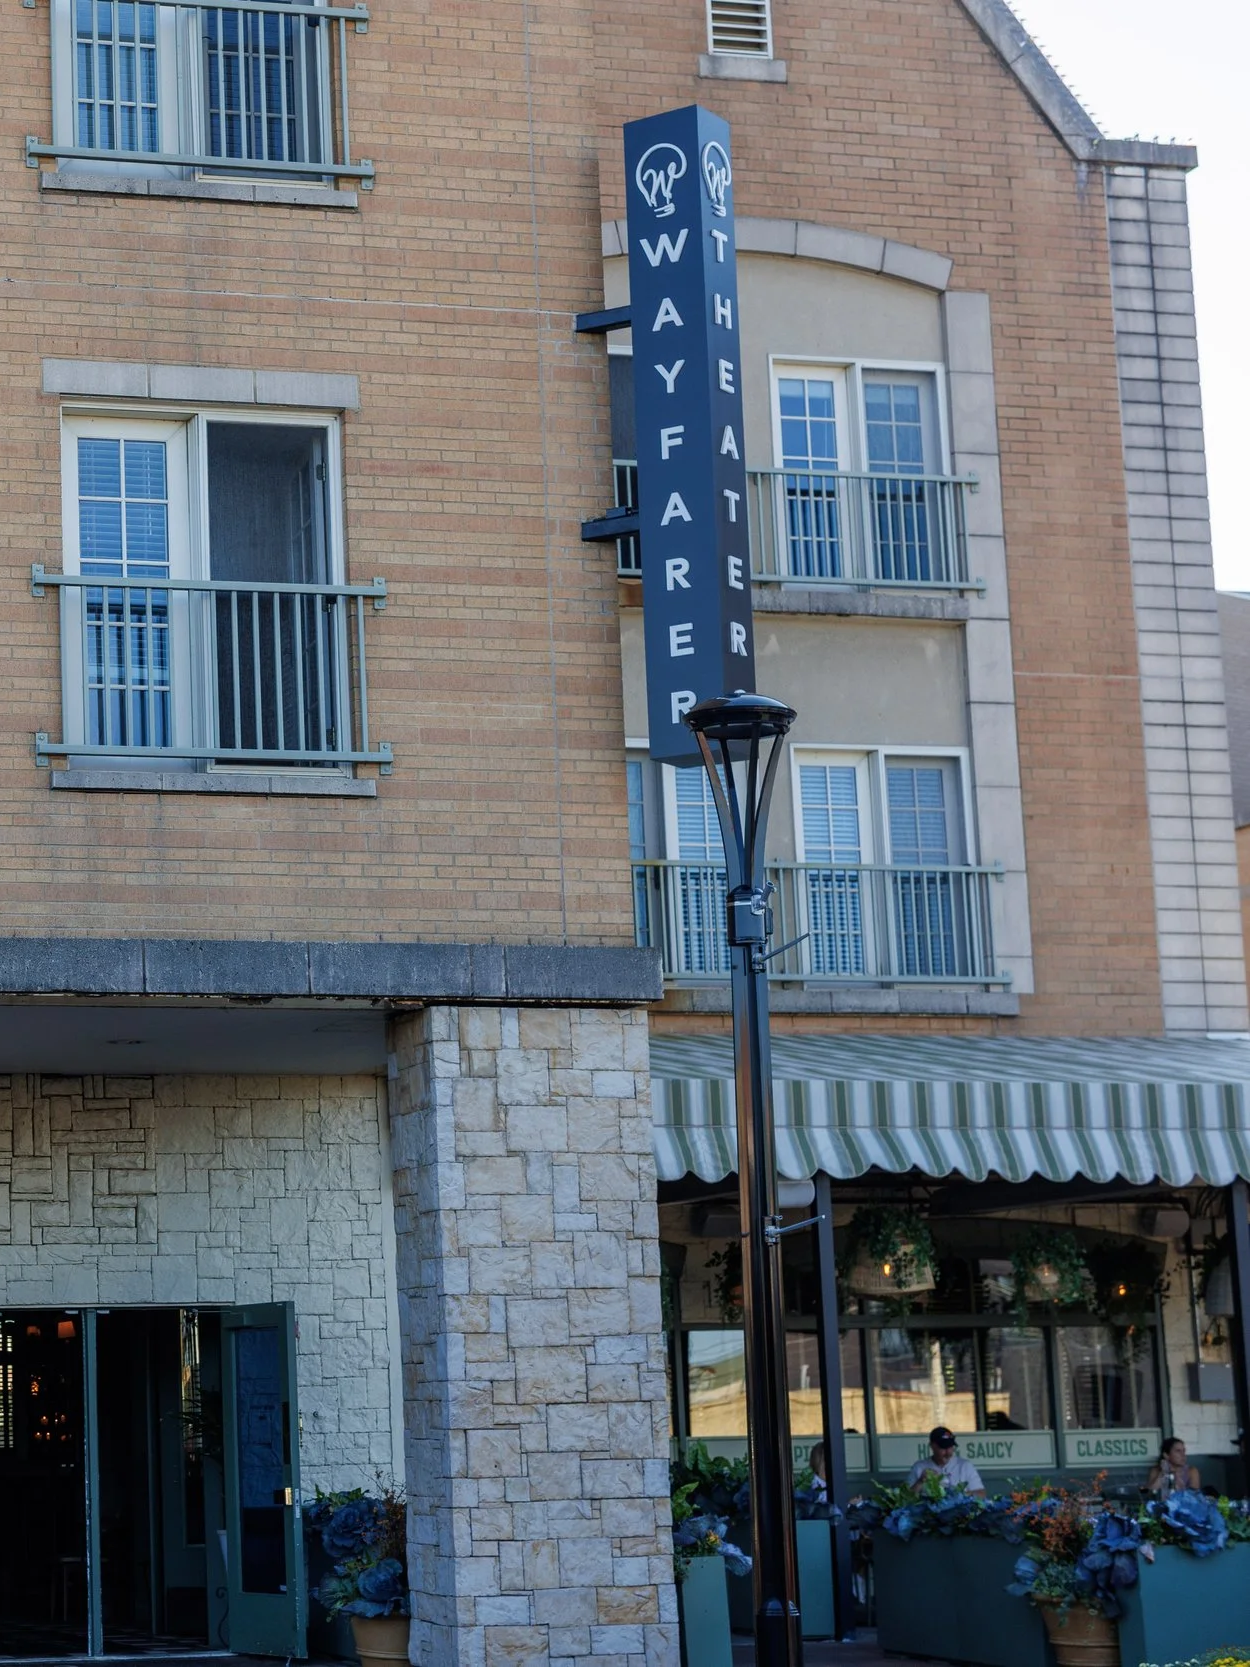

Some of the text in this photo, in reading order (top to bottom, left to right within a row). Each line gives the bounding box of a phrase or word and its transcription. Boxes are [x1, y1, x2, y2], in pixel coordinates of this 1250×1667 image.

[639, 228, 698, 724] WAYFARER
[710, 228, 748, 694] THEATER
[966, 1441, 1014, 1459] SAUCY
[1077, 1438, 1148, 1457] CLASSICS
